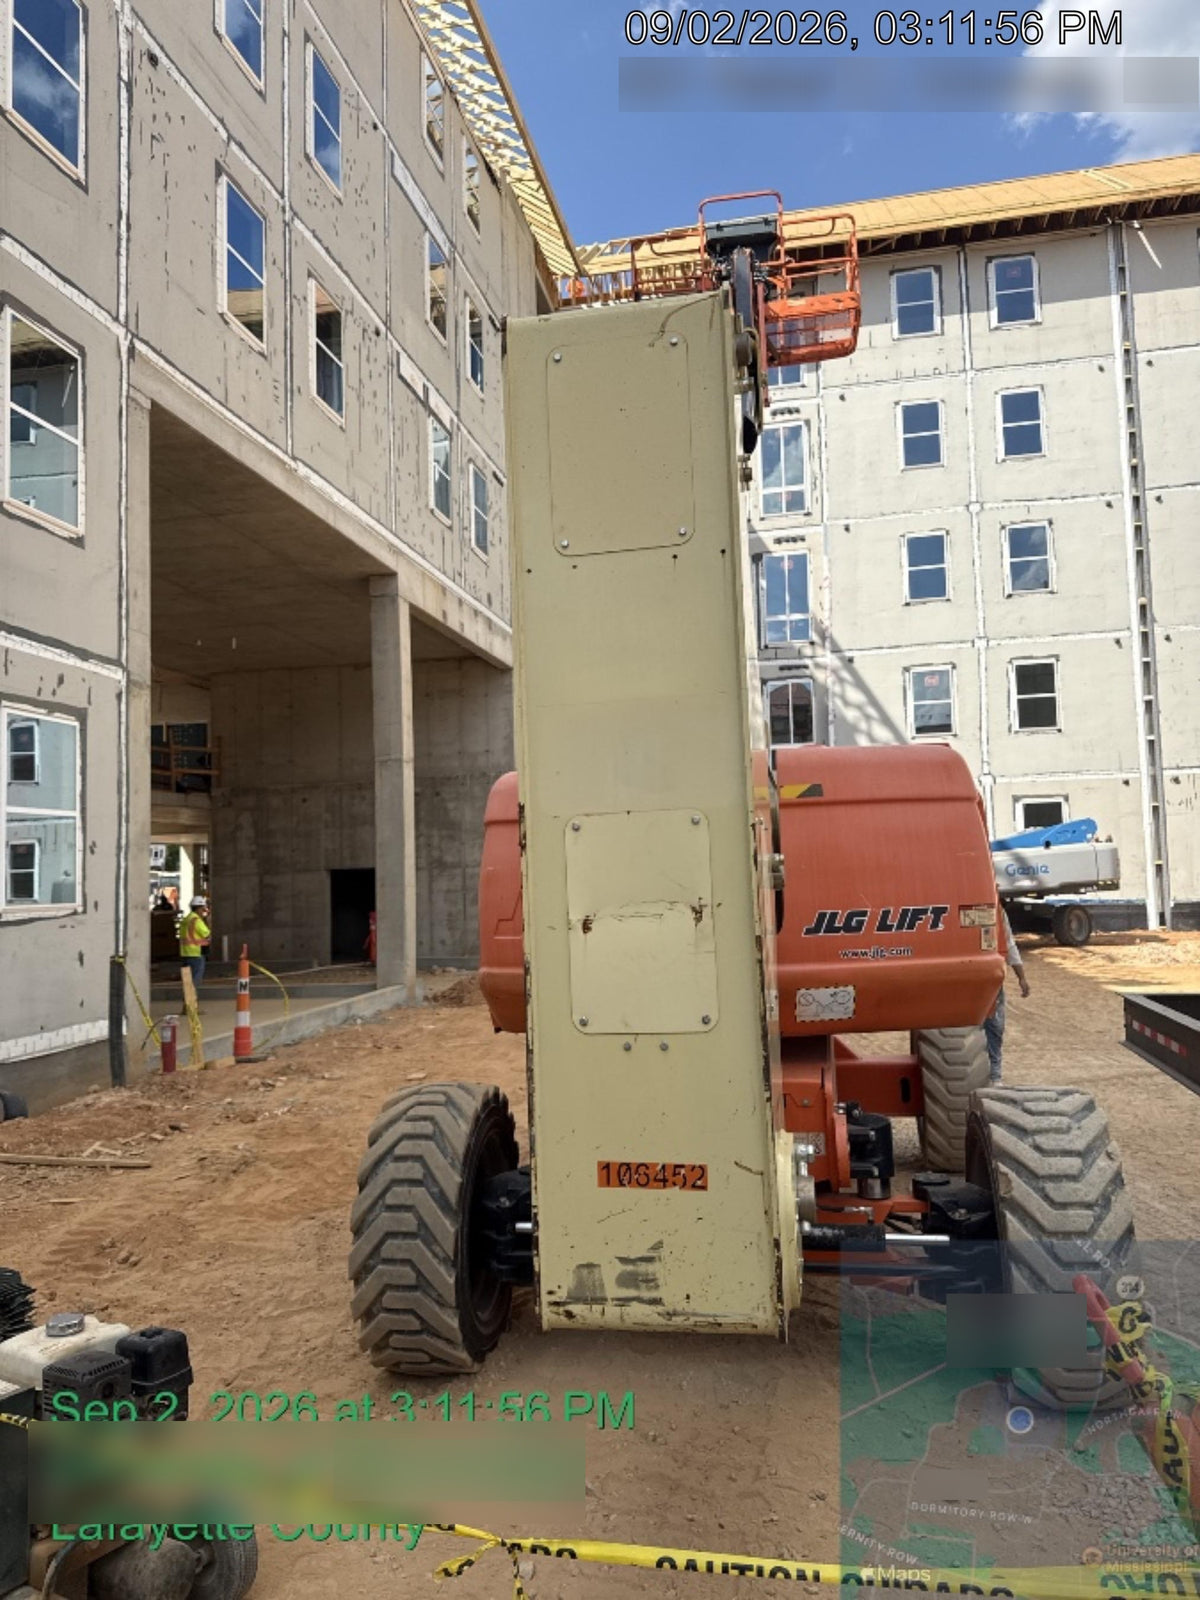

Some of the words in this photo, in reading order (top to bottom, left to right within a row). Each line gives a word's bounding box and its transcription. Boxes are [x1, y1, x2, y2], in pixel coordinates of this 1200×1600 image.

[1004, 863, 1050, 877] Genie
[802, 909, 871, 937] JLG
[874, 904, 950, 934] LIFT
